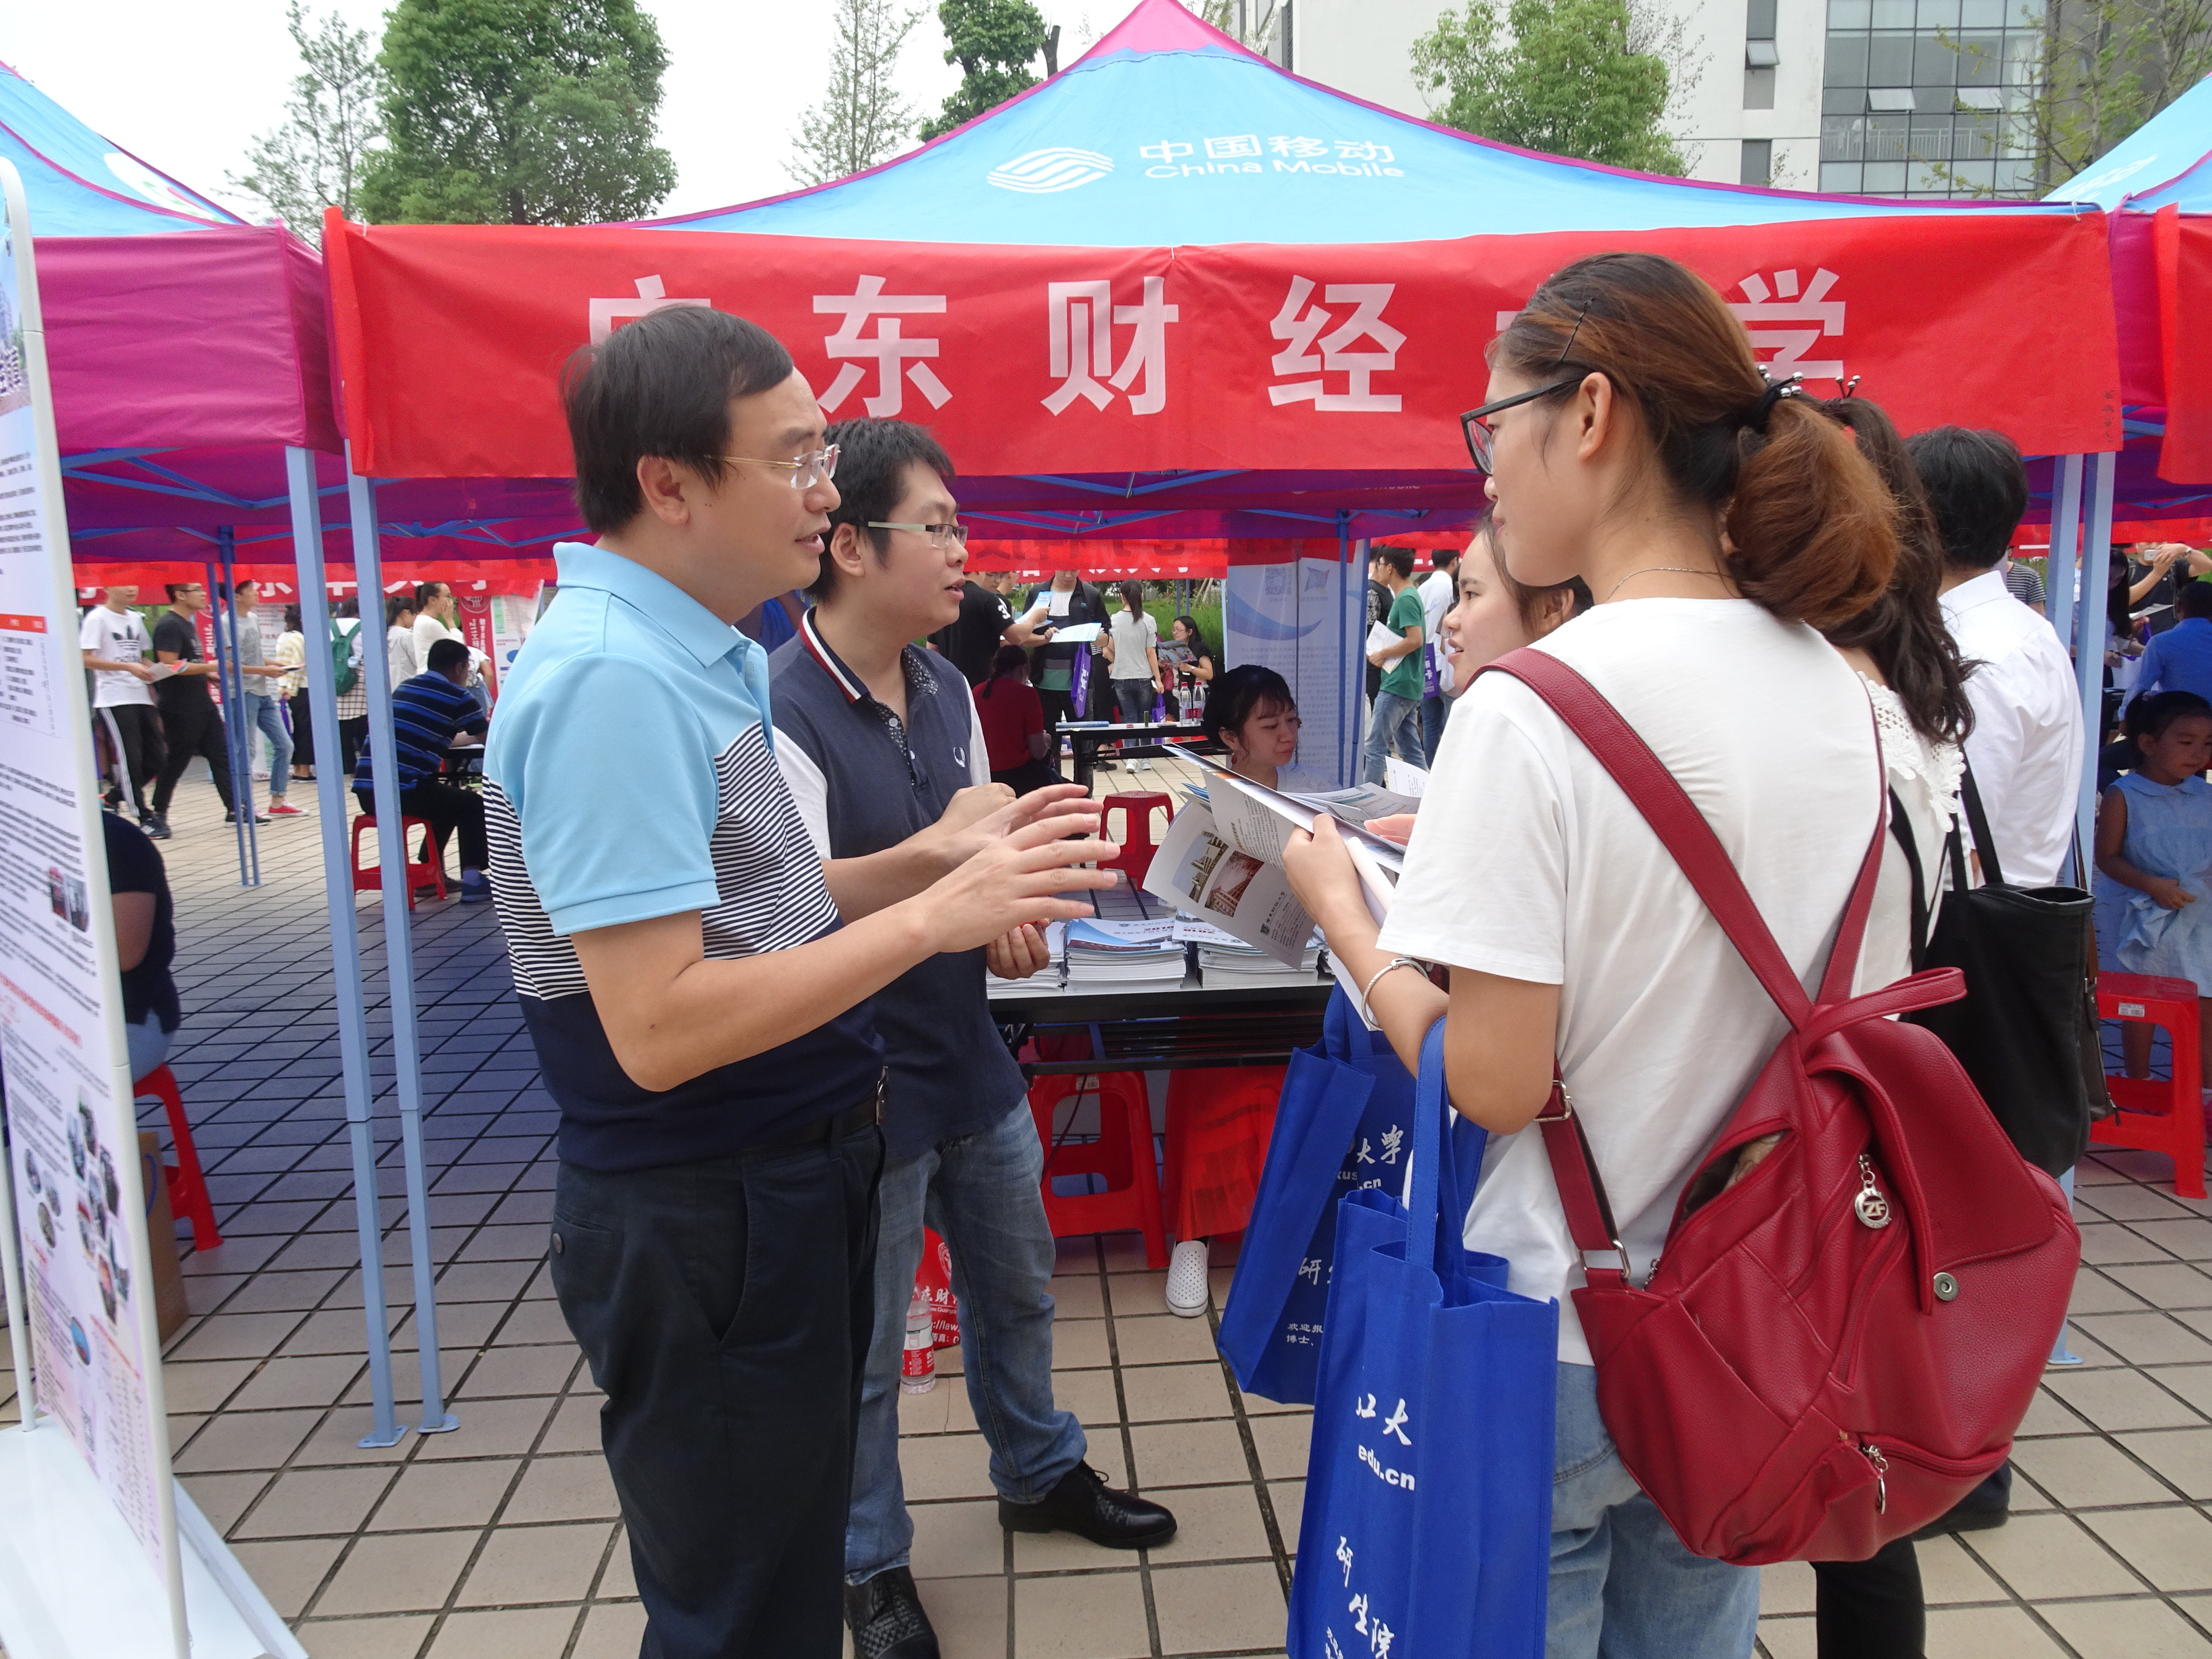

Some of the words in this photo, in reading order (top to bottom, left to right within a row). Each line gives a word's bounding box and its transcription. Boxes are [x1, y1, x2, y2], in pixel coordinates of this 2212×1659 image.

[1139, 134, 1395, 164] 中国移动
[1145, 162, 1263, 178] China
[1272, 159, 1405, 177] Mobile
[589, 267, 1846, 418] 广东财经学
[1288, 1323, 1323, 1333] 欢迎报
